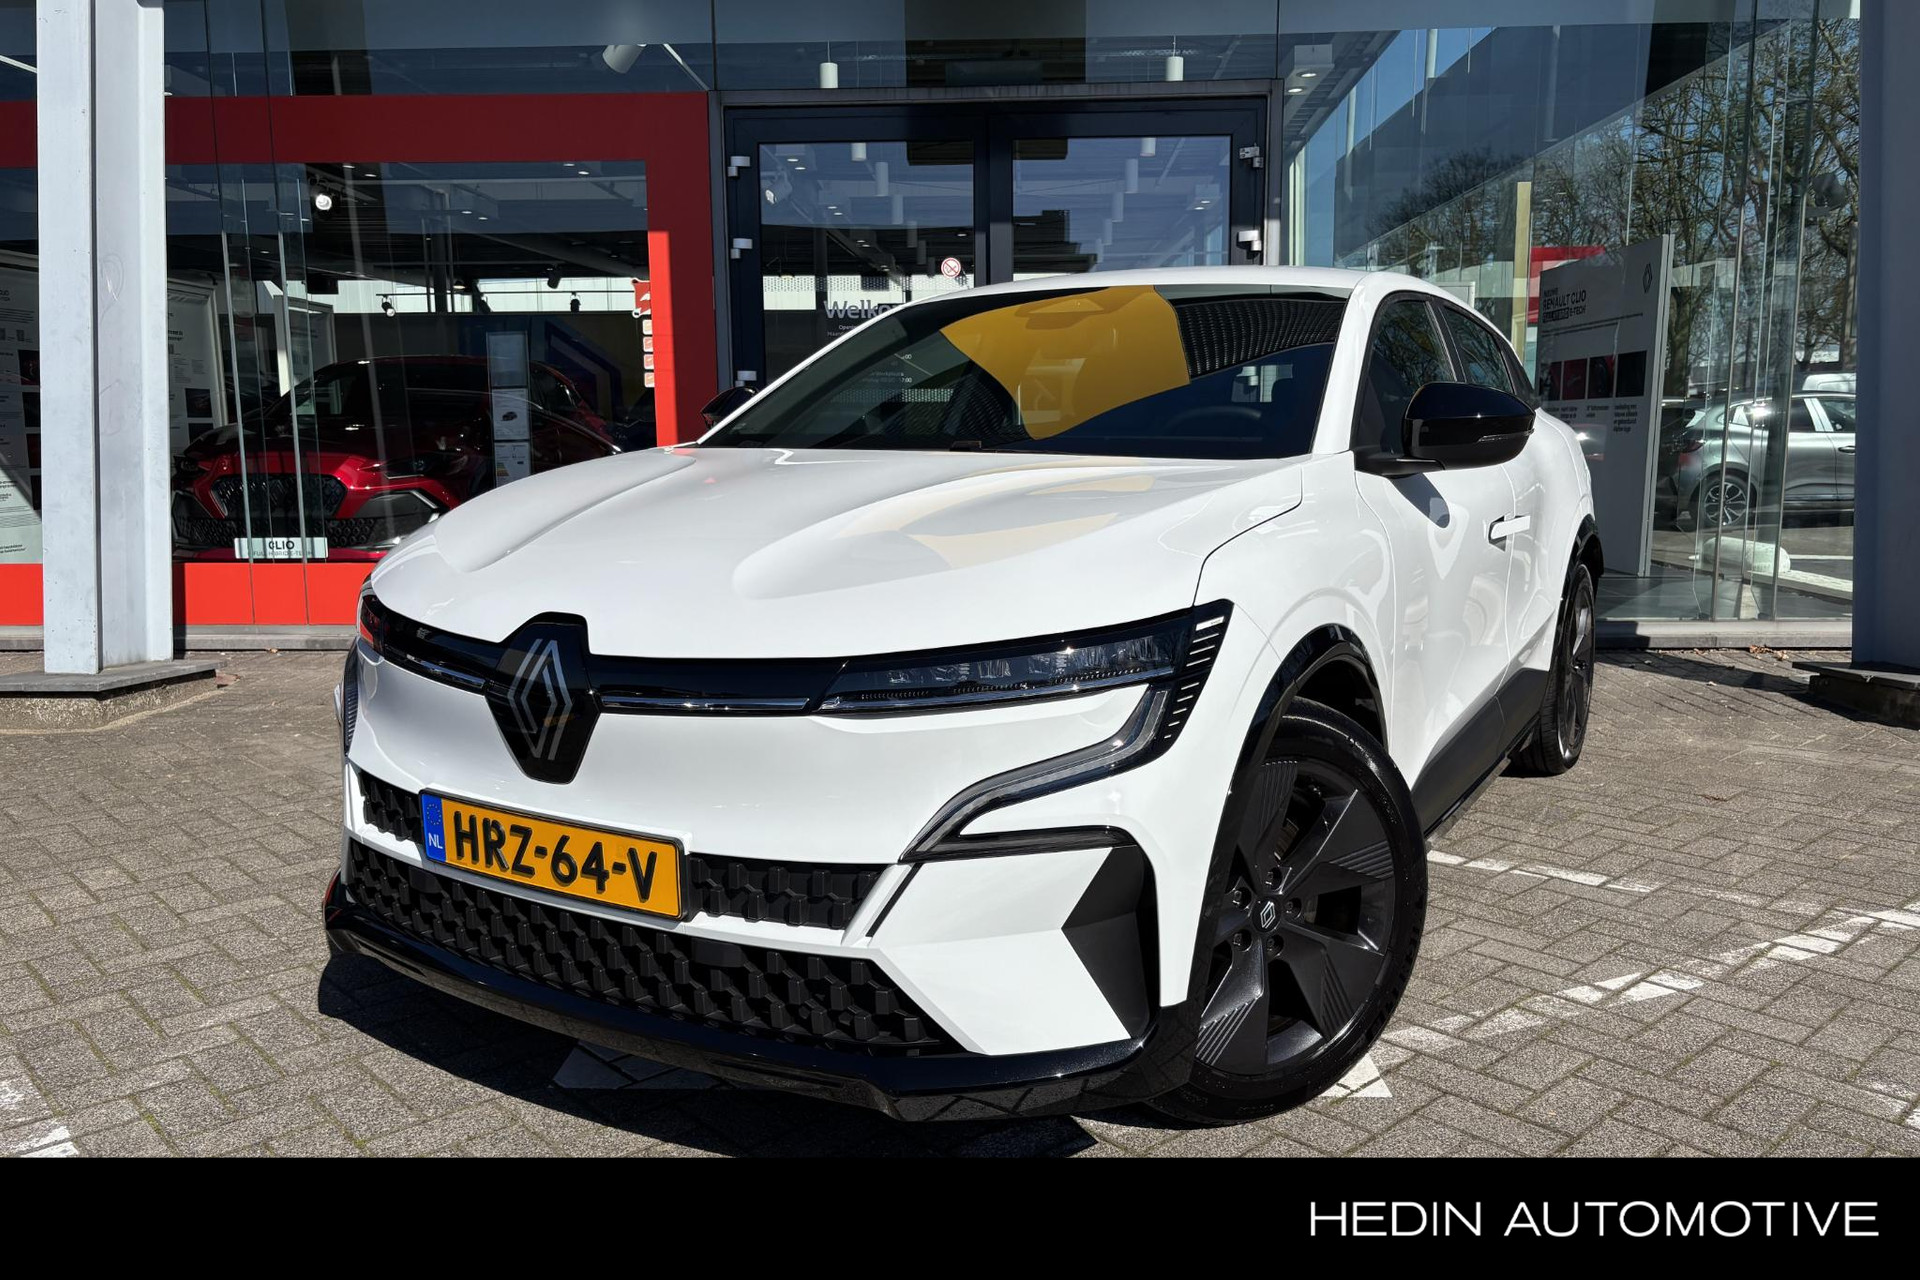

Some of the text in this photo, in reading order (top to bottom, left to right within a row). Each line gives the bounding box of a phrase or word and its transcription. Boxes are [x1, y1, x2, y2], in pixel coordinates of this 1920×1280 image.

[1570, 289, 1587, 305] CLIO
[268, 540, 295, 550] CLIO
[428, 811, 657, 903] NL HRZ-64-V
